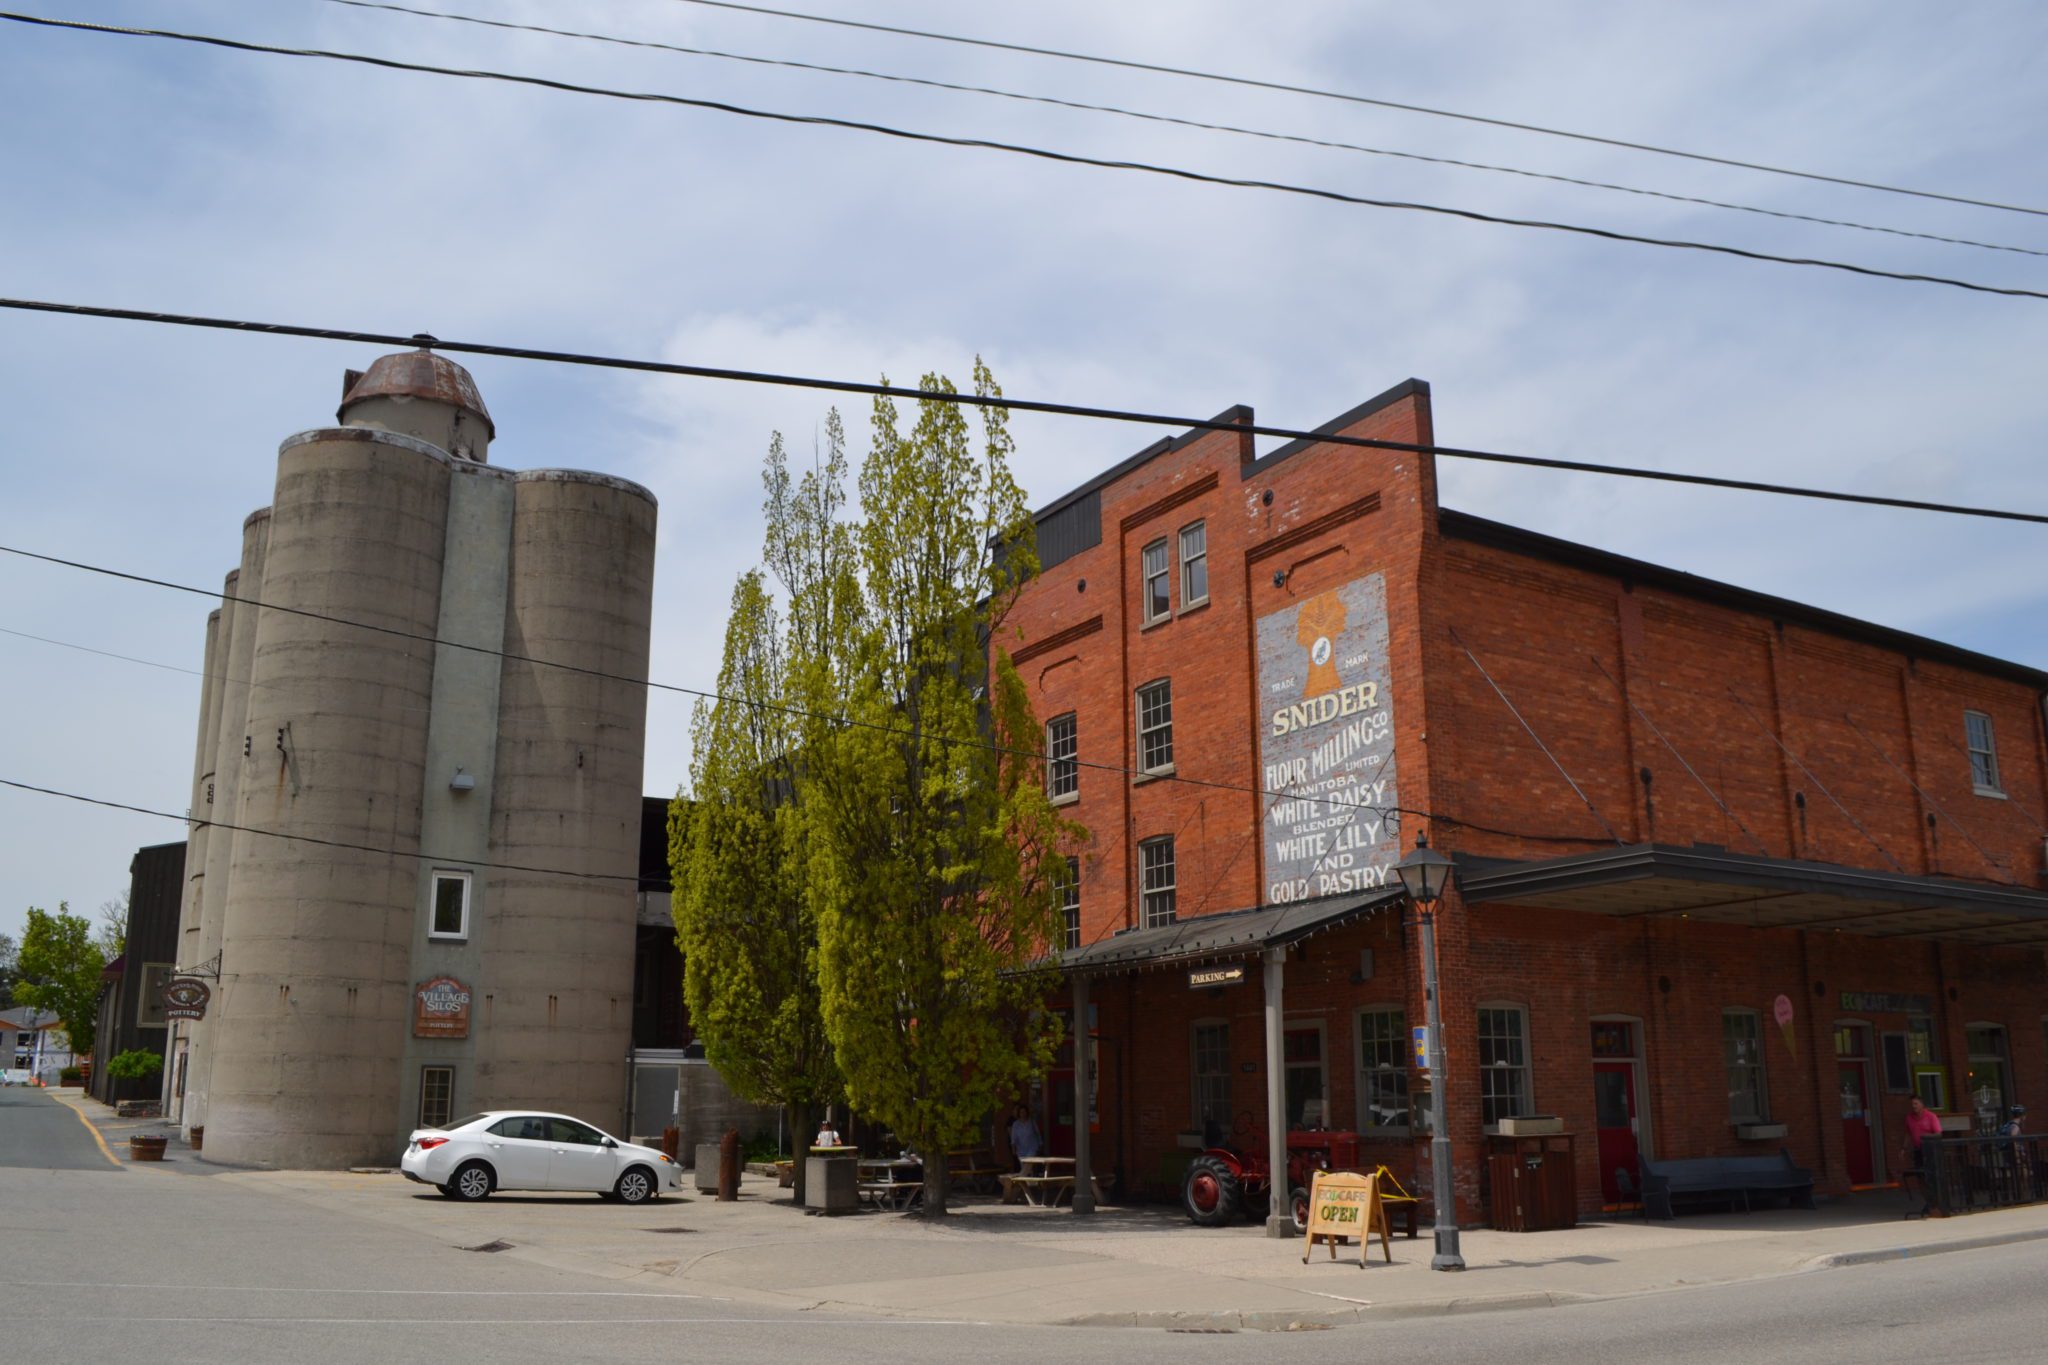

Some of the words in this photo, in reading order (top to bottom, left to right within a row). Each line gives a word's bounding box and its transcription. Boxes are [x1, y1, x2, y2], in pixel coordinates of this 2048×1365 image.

[1272, 677, 1296, 693] TRADE
[1345, 652, 1369, 668] MARK
[1272, 681, 1379, 738] SNIDER
[1266, 757, 1307, 792] FLOUR
[1312, 716, 1374, 780] MILLING
[1372, 710, 1389, 730] CO
[1345, 754, 1380, 773] LIMITED
[1291, 774, 1358, 799] MANITOBA
[1271, 796, 1321, 827] WHITE
[1328, 779, 1387, 815] DAISY
[1293, 813, 1356, 836] BLENDED
[1275, 832, 1327, 864] WHITE
[1335, 820, 1381, 852] LILY
[1311, 853, 1354, 873] AND
[1271, 879, 1310, 905] GOLD
[1319, 863, 1390, 897] PASTRY
[438, 983, 451, 993] THE
[1190, 971, 1226, 985] PARKING
[417, 991, 470, 1004] VILLAGE
[426, 1000, 461, 1013] SILOS
[168, 1010, 201, 1018] POTTERY
[1321, 1205, 1360, 1223] OPEN
